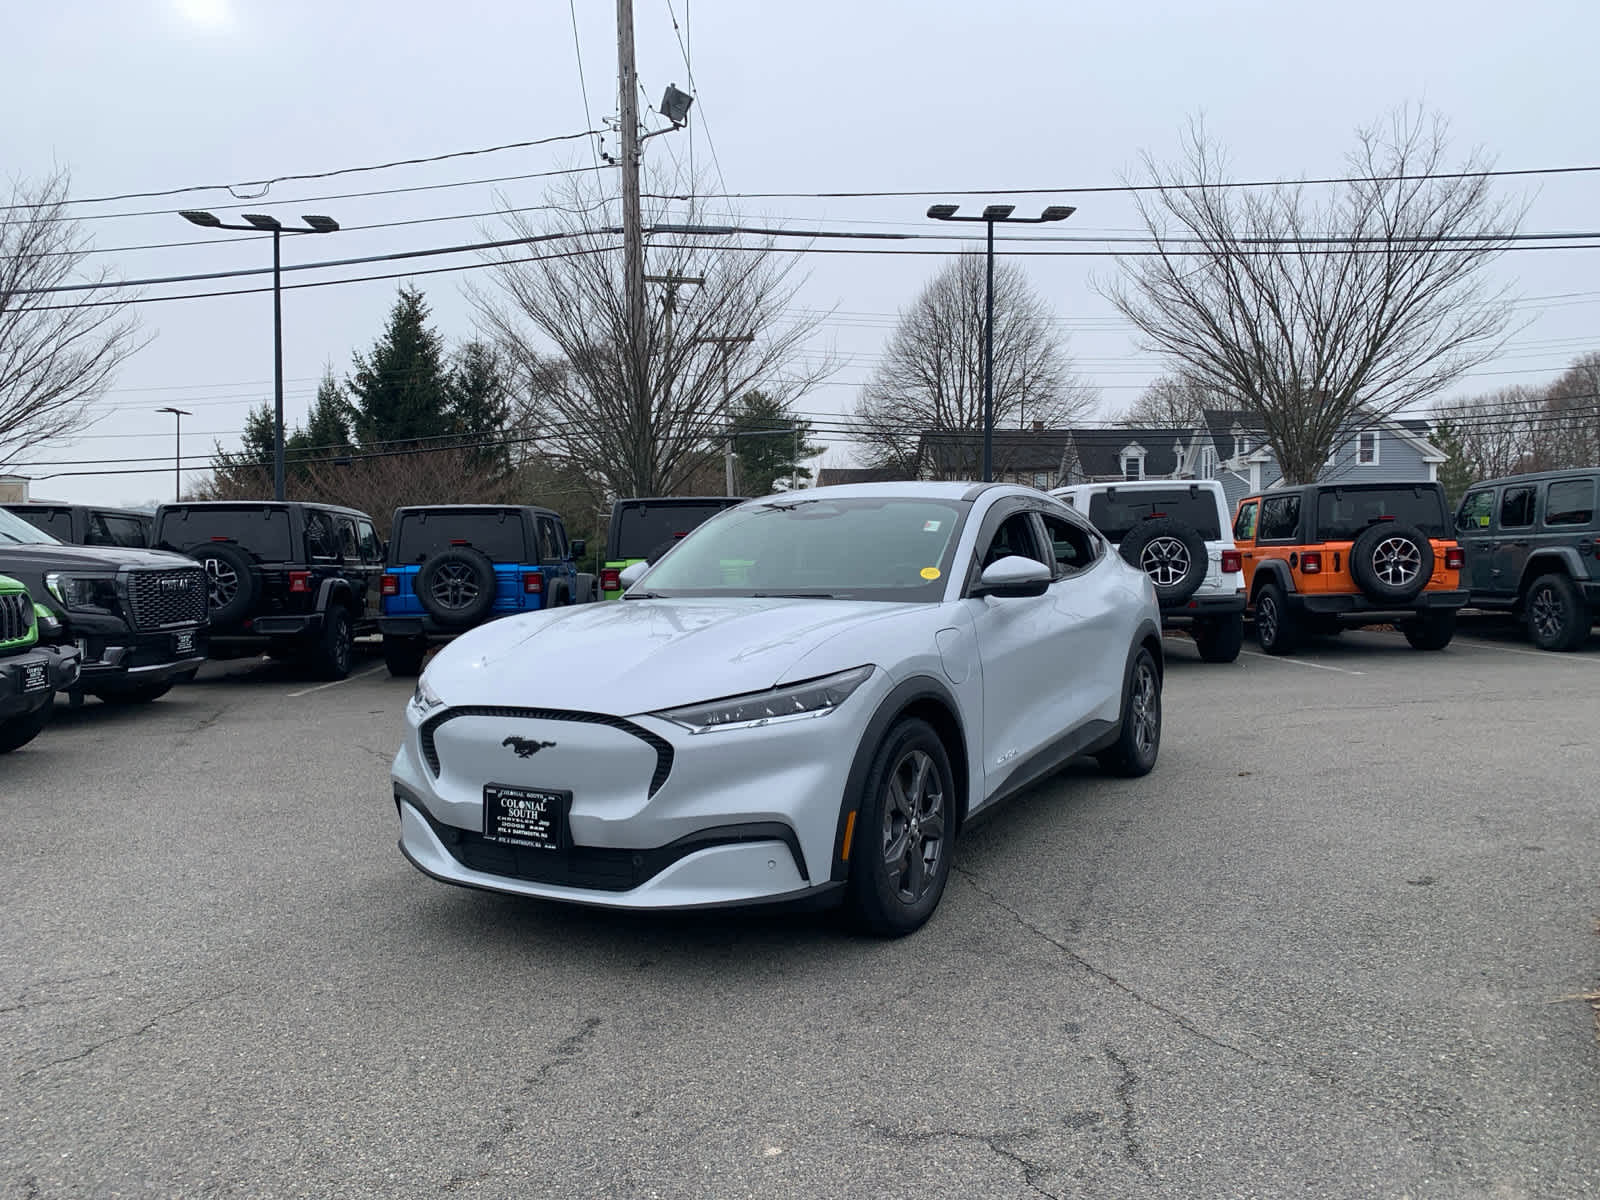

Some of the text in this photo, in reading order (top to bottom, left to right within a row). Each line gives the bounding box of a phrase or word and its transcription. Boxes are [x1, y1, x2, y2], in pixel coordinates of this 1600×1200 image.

[501, 798, 546, 812] COLONIAL
[508, 808, 538, 820] SOUTH
[497, 815, 534, 824] CHRYSLER
[501, 821, 525, 829] DODGE
